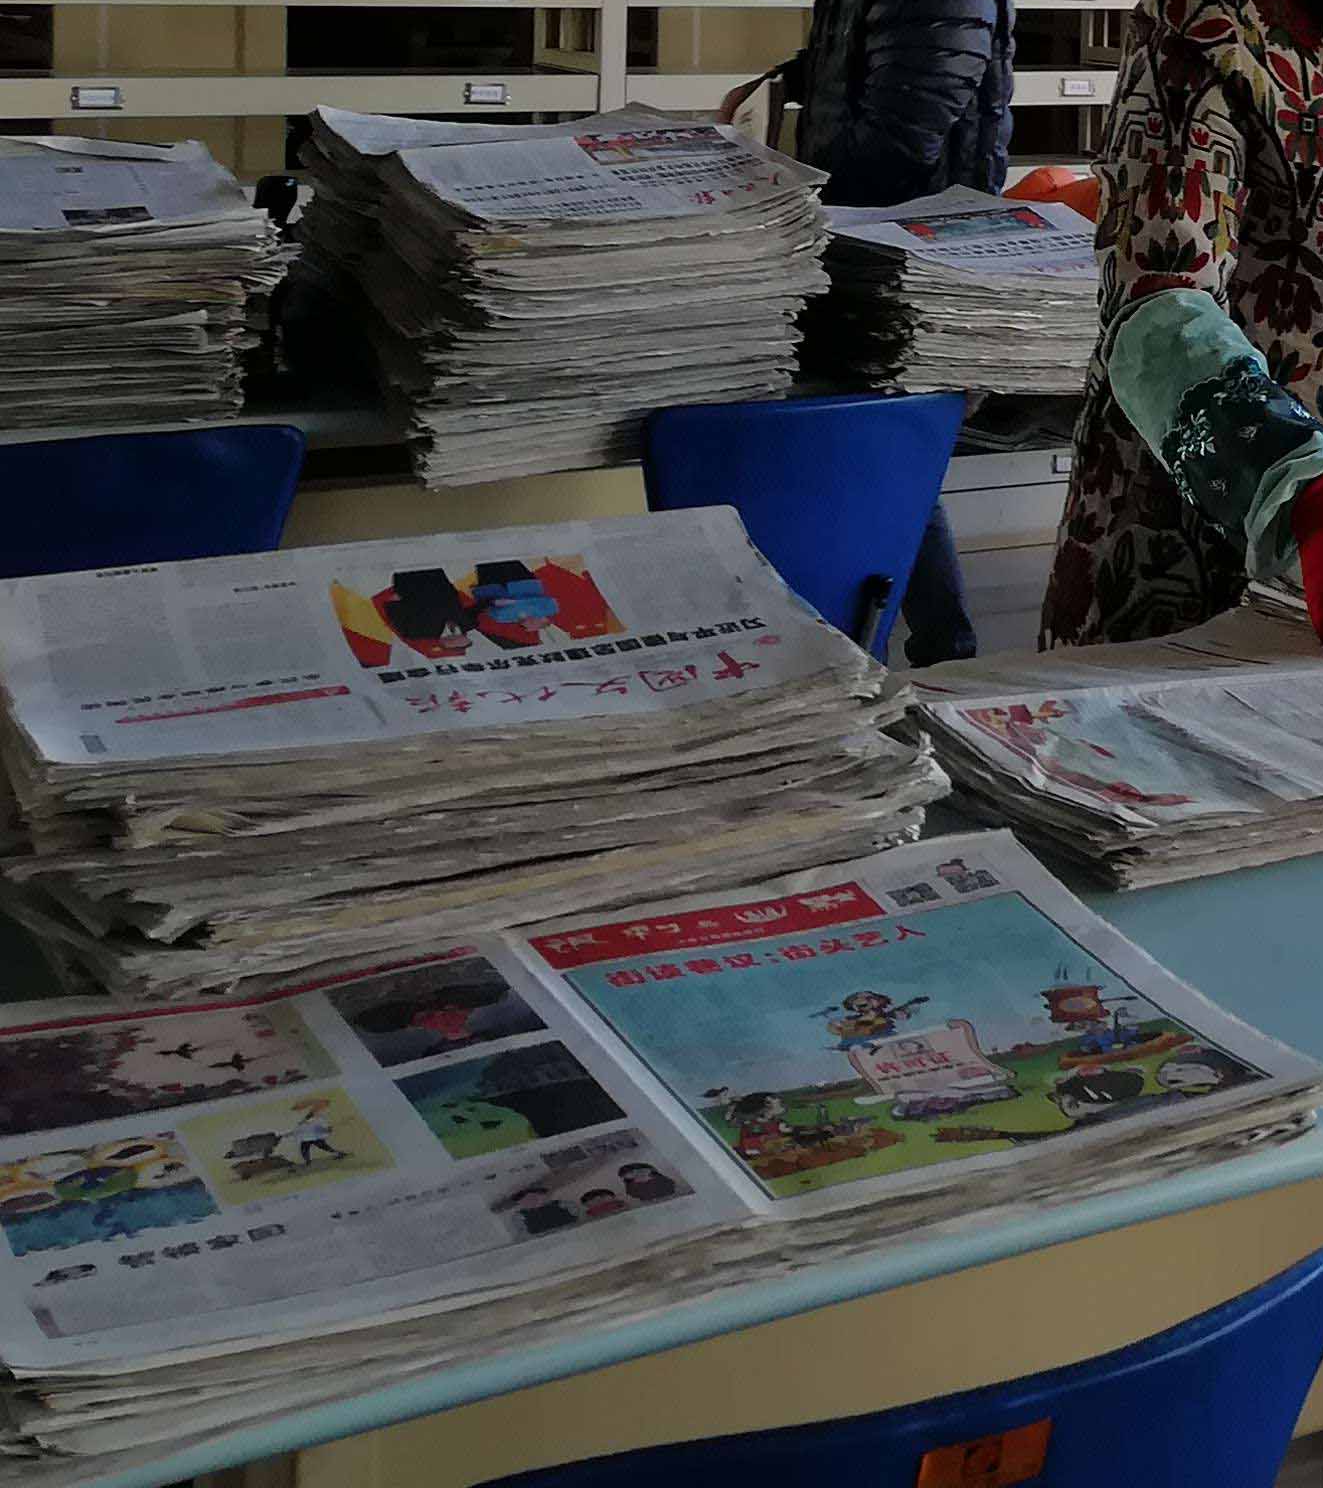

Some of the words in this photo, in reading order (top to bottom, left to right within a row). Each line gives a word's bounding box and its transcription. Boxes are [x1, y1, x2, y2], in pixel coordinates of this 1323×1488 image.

[377, 616, 768, 685] 习近平与德国总理默克尔举行会谈
